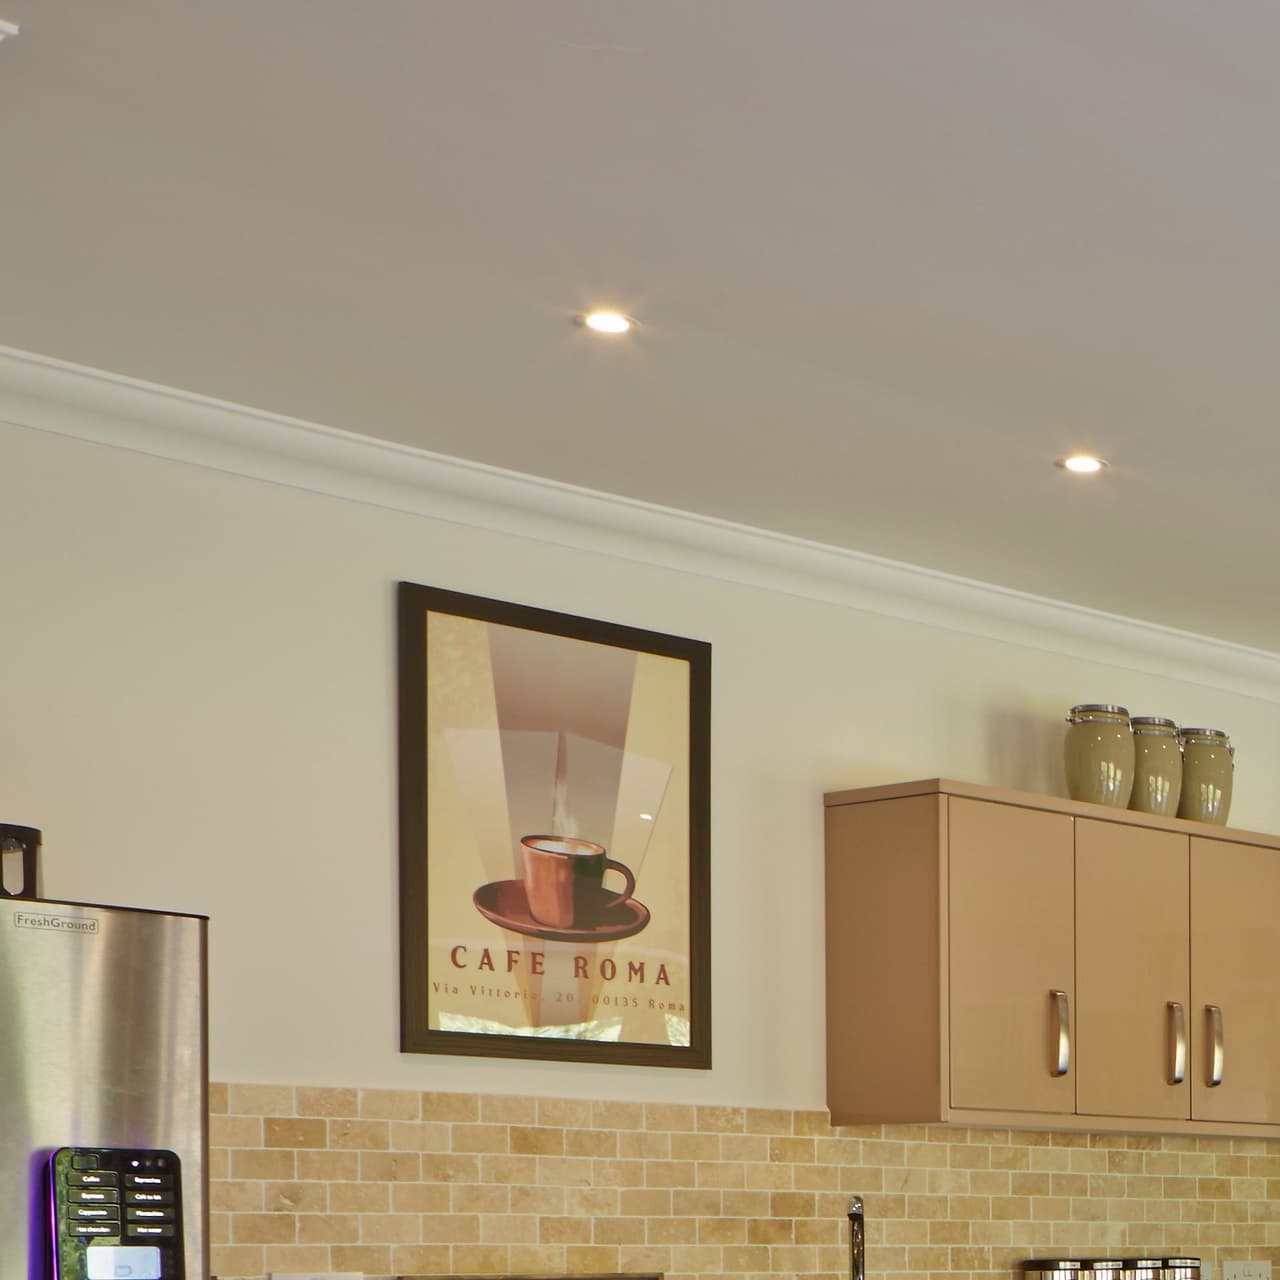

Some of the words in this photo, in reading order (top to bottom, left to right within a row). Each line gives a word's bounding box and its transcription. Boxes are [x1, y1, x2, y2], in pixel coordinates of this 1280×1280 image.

[17, 914, 96, 931] FreshGround
[450, 945, 545, 976] CAFE
[573, 955, 671, 986] ROMA
[433, 982, 459, 994] Via
[592, 994, 638, 1008] 00135
[648, 999, 685, 1012] Roma
